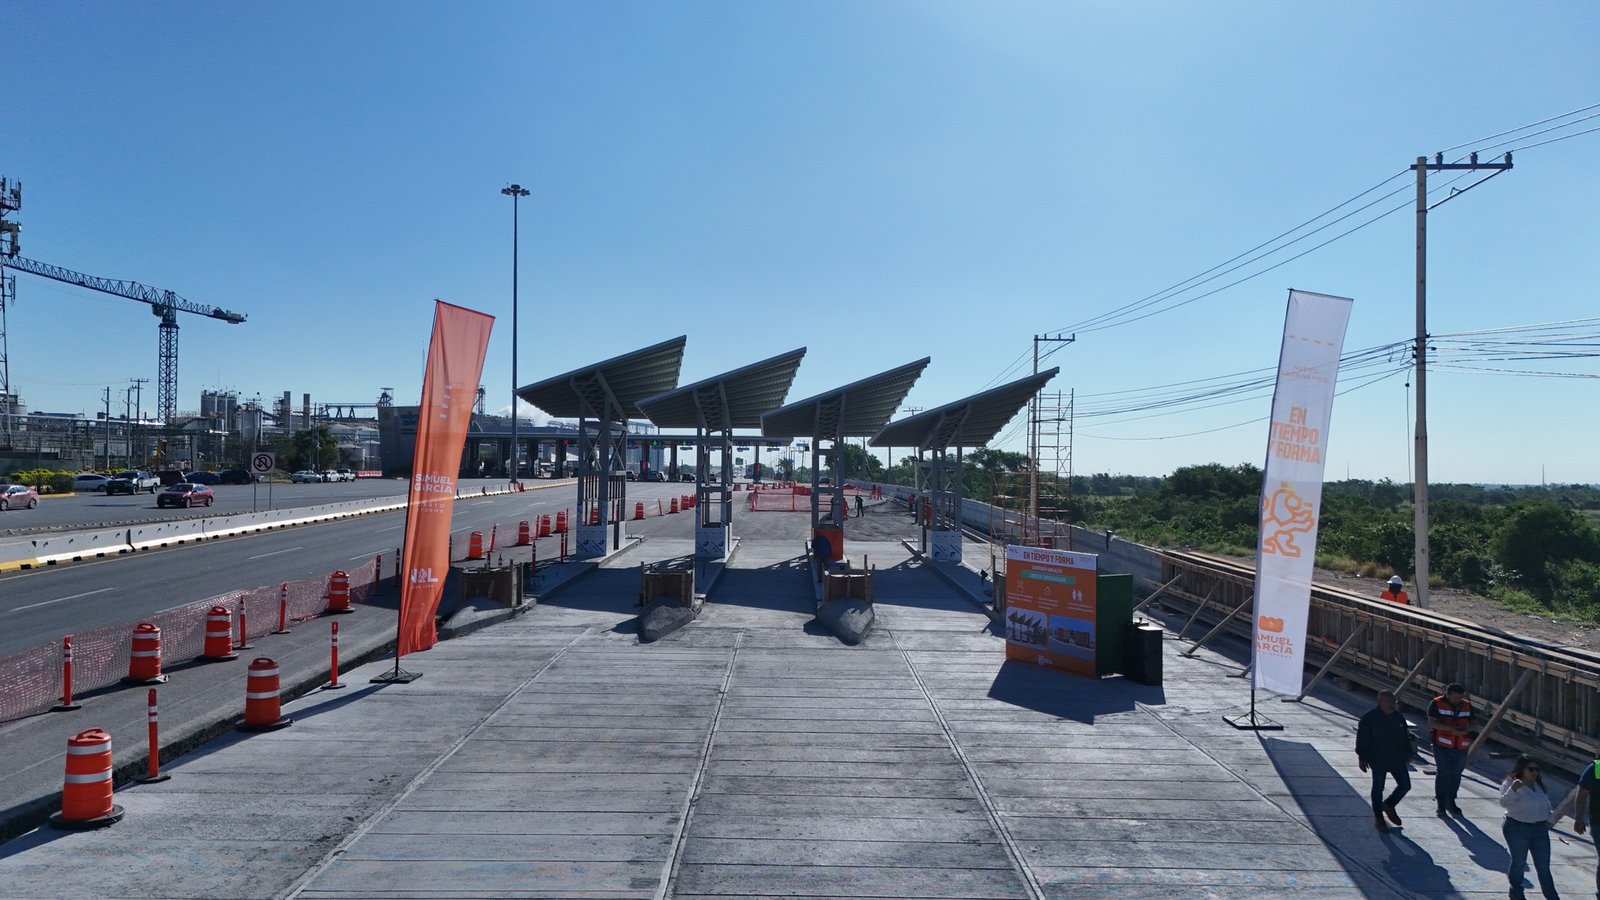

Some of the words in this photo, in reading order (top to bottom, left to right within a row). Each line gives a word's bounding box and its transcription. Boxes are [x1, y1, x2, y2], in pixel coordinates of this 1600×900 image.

[1290, 406, 1307, 424] EN
[1272, 422, 1319, 445] TIEMPO
[1276, 441, 1320, 464] FORMA
[1023, 551, 1030, 560] EN
[1030, 552, 1050, 562] TIEMPO
[1055, 555, 1074, 565] FORMA
[1255, 634, 1293, 645] AMUEL
[1255, 642, 1292, 655] ARCÍA
